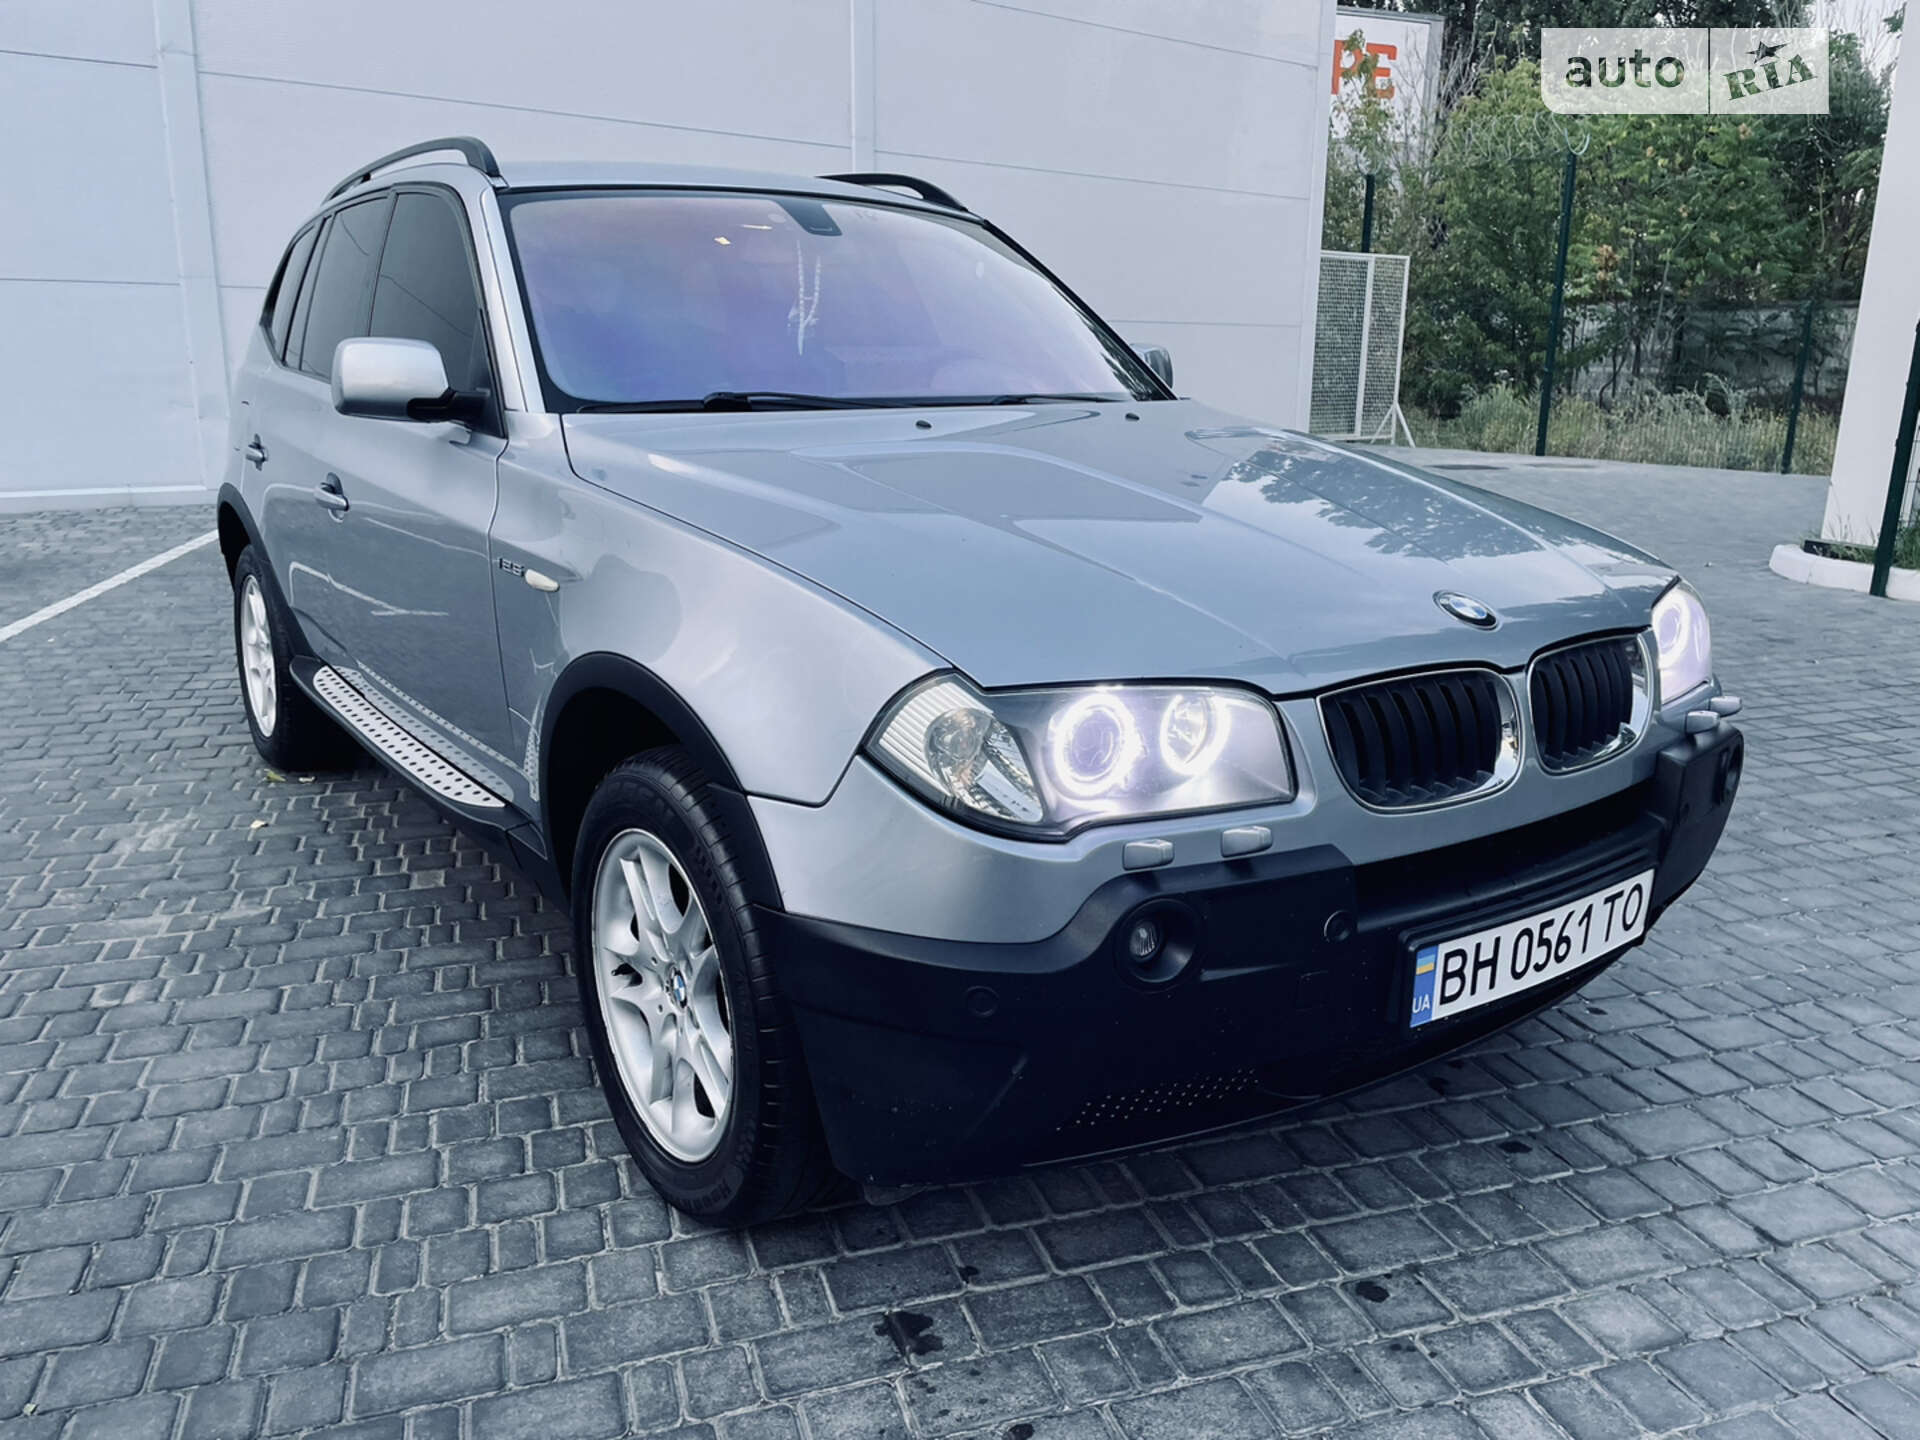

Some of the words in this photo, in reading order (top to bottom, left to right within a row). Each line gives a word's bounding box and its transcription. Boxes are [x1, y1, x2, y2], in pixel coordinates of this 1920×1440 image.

[1439, 936, 1501, 1006] BH
[1510, 903, 1593, 980] 0561
[1603, 882, 1643, 943] TO
[1412, 994, 1431, 1014] UA
